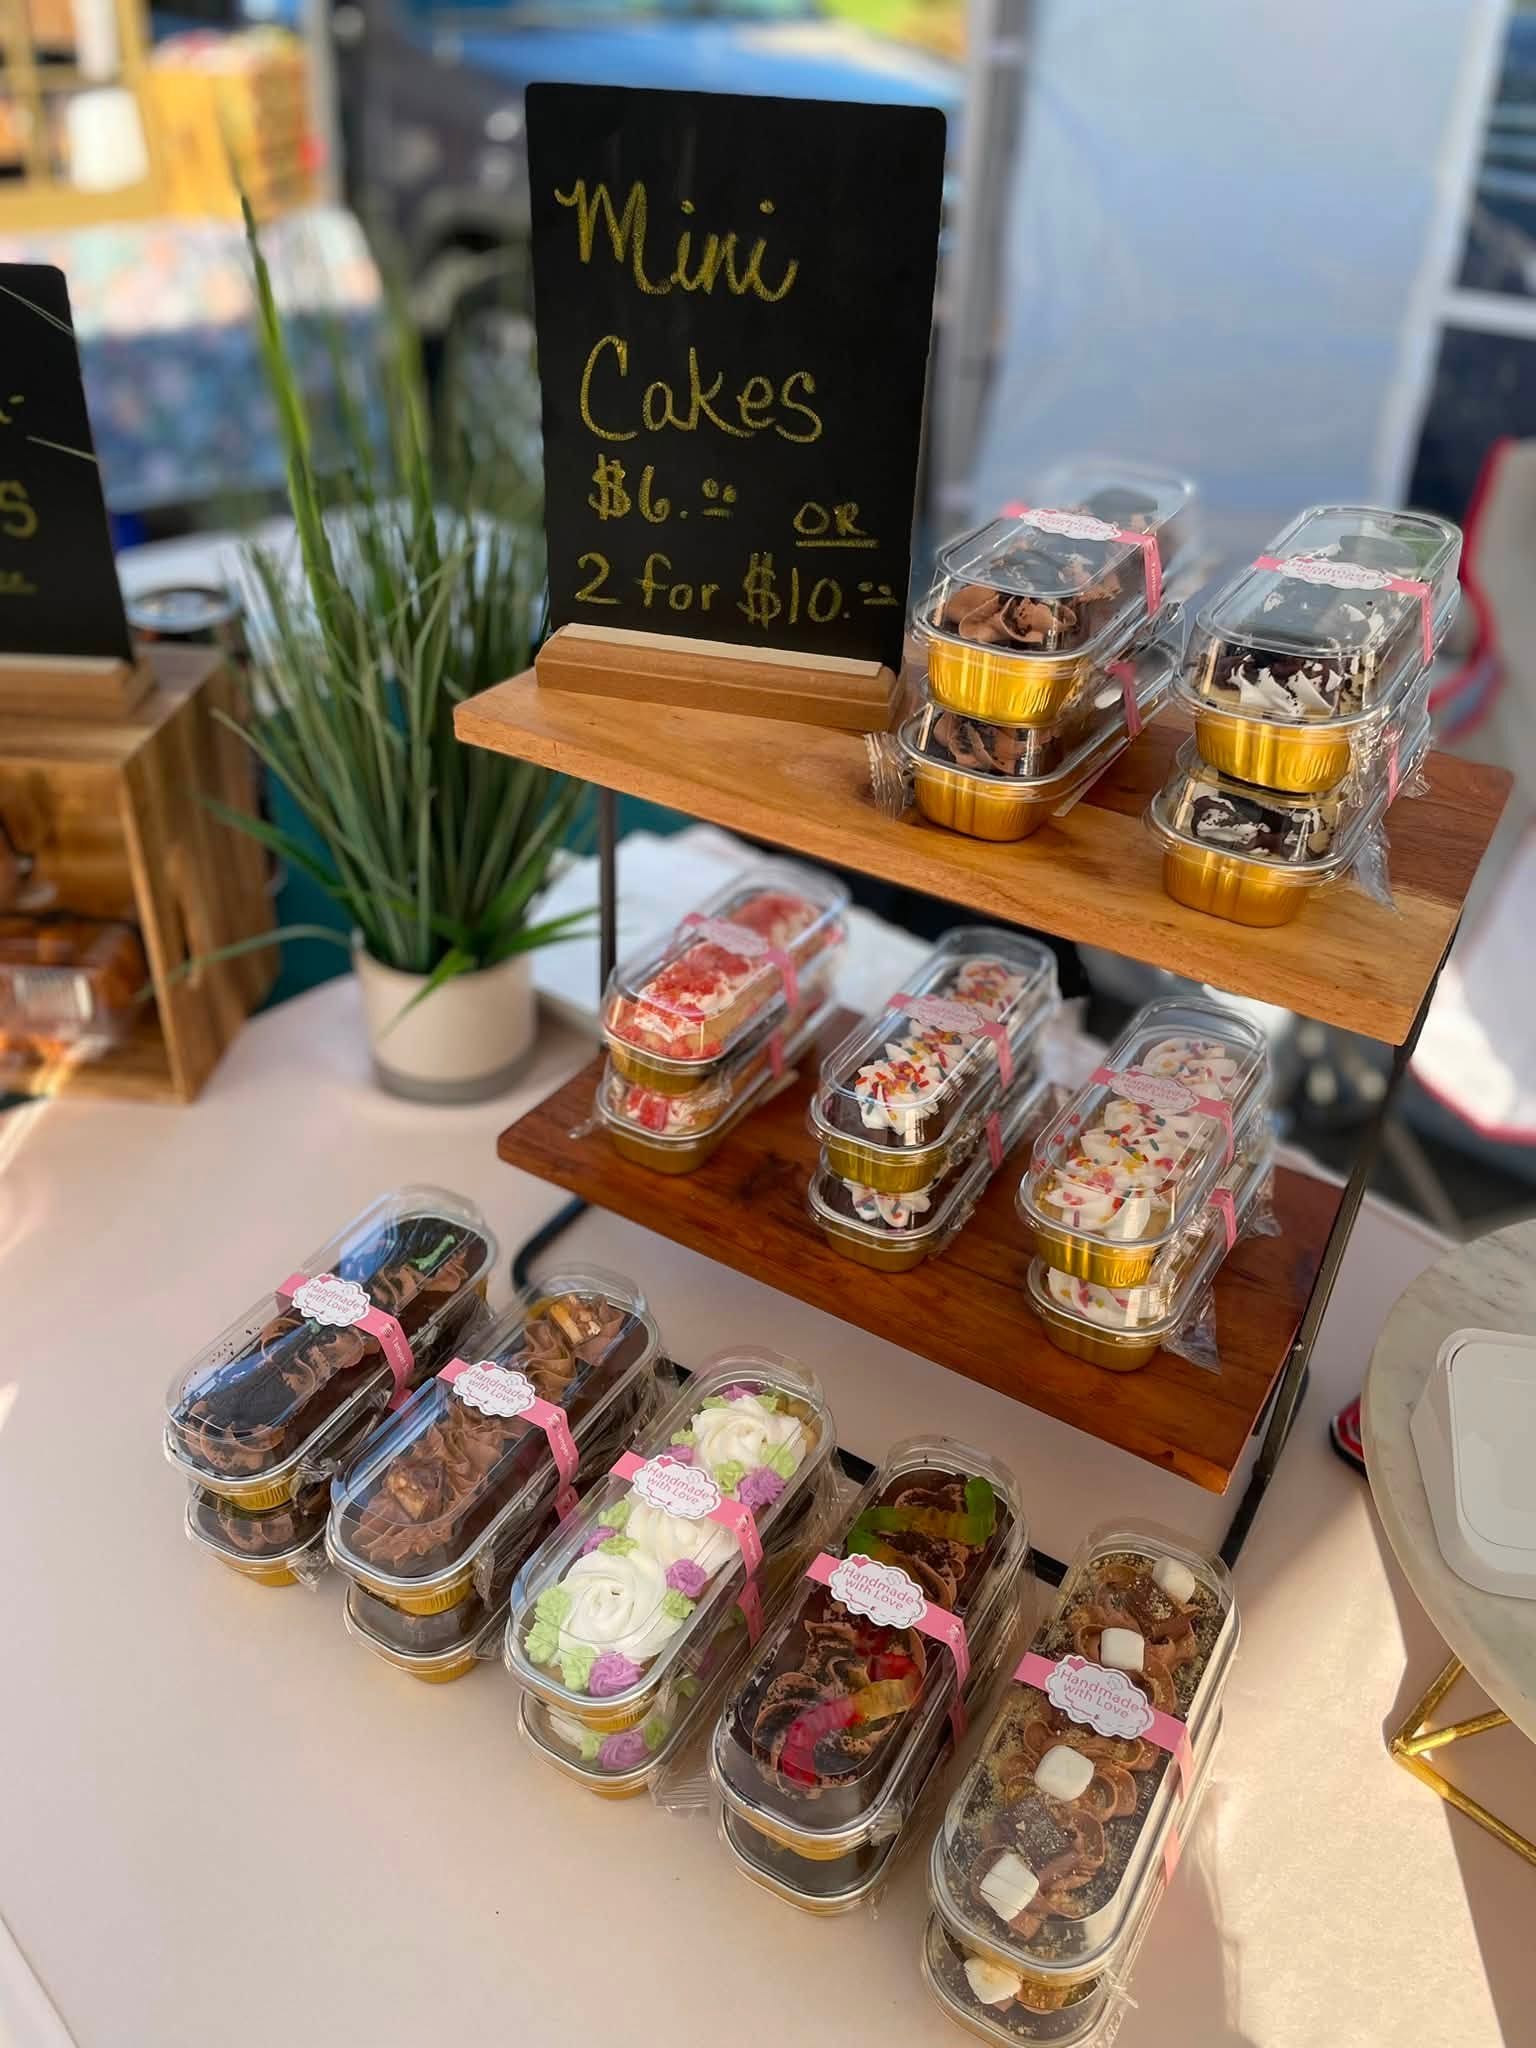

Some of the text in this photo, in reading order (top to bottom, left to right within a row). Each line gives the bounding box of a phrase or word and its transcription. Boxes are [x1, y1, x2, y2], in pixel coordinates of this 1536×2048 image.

[554, 177, 799, 302] Mini
[580, 335, 823, 442] Cakes
[575, 552, 621, 604] 2
[633, 552, 720, 612] for
[470, 1369, 526, 1400] Handmade
[490, 1389, 514, 1405] Love
[647, 1466, 709, 1500] Handmade
[672, 1486, 700, 1506] Love
[843, 1567, 914, 1605] Handmade
[845, 1579, 904, 1610] with Love
[1060, 1669, 1139, 1712] Handmade
[1063, 1683, 1129, 1720] with Love
